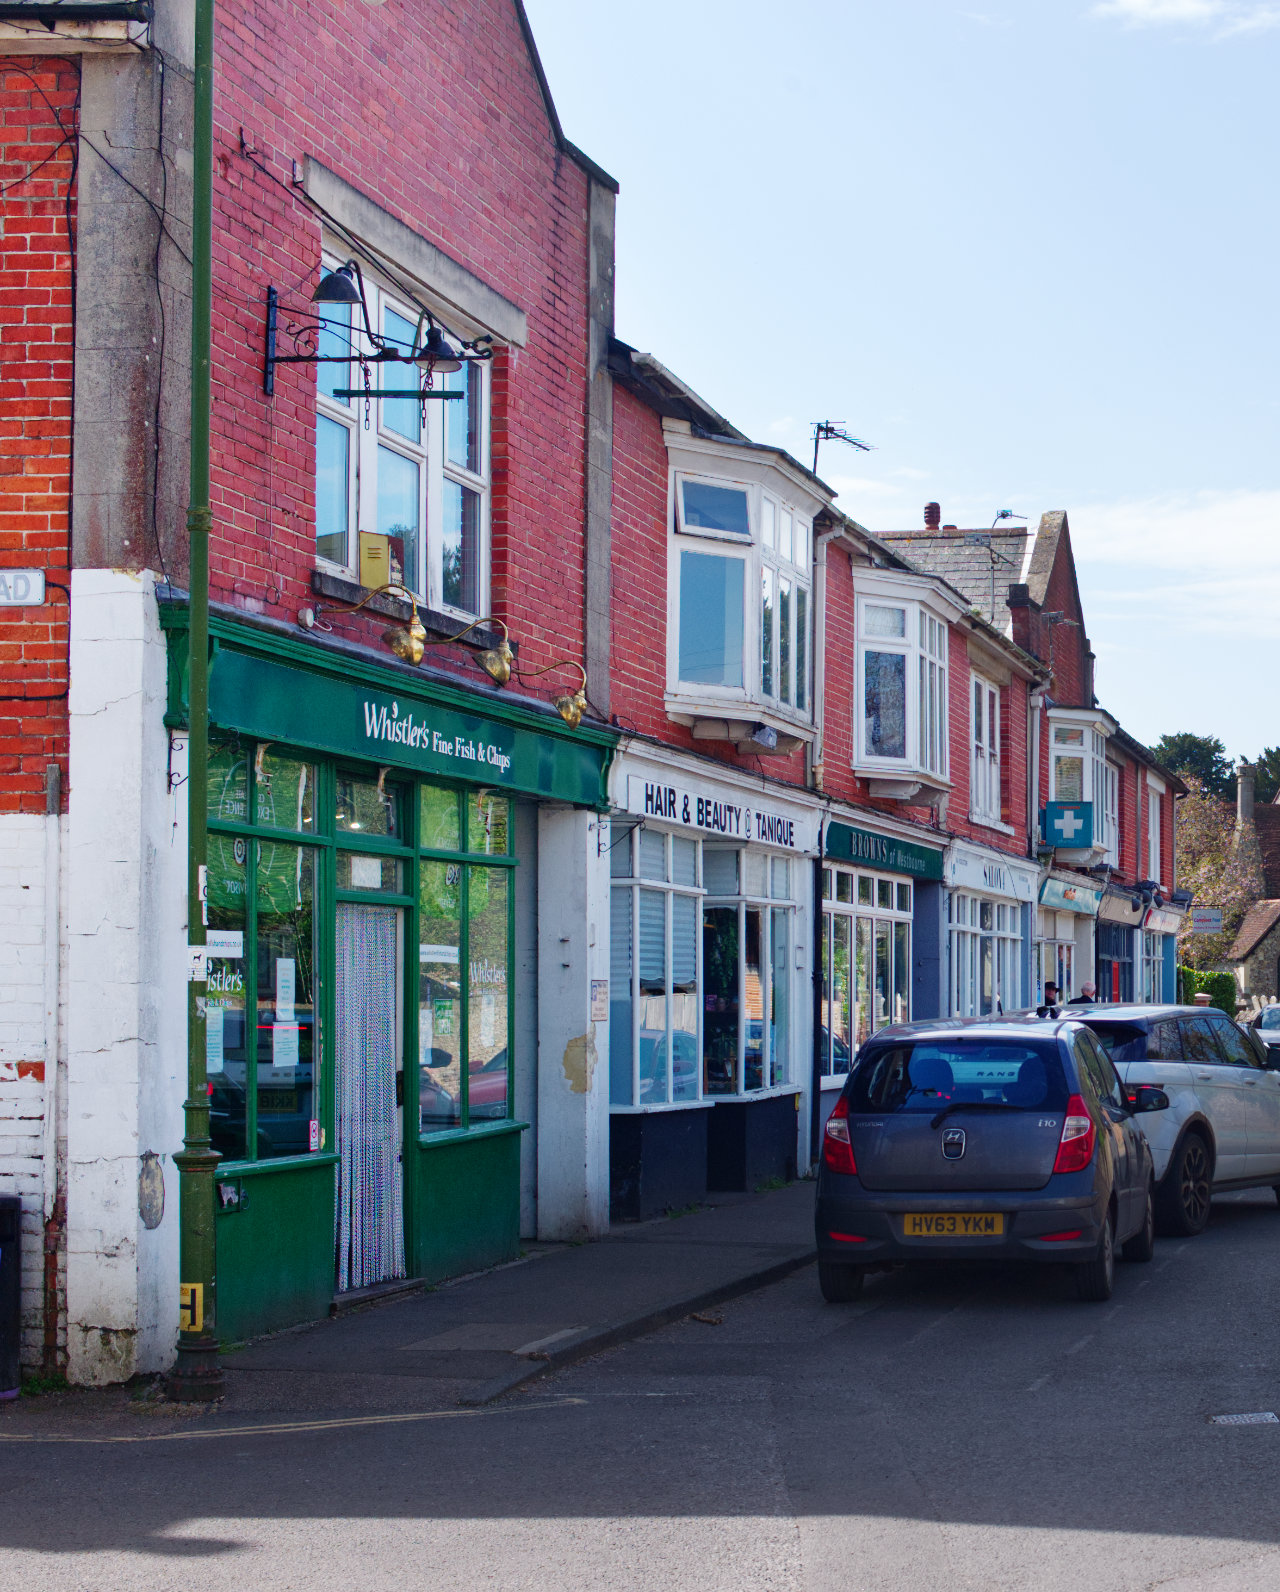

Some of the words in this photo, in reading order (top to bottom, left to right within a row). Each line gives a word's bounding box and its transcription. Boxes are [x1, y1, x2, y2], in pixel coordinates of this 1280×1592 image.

[364, 701, 430, 749] Whistler's
[432, 731, 453, 755] Fine
[455, 736, 476, 760] Fish
[477, 742, 486, 762] &
[487, 744, 511, 773] Chips
[645, 782, 677, 819] HAIR
[682, 794, 691, 824] &
[697, 797, 742, 834] BEAUTY
[755, 812, 795, 848] TANIQUE
[852, 831, 888, 864] BROWNS
[889, 848, 896, 864] of
[897, 849, 926, 872] Westbourne
[207, 959, 243, 992] istler's
[1038, 1119, 1056, 1128] i10
[912, 1216, 957, 1233] HV63
[961, 1216, 995, 1233] YKM
